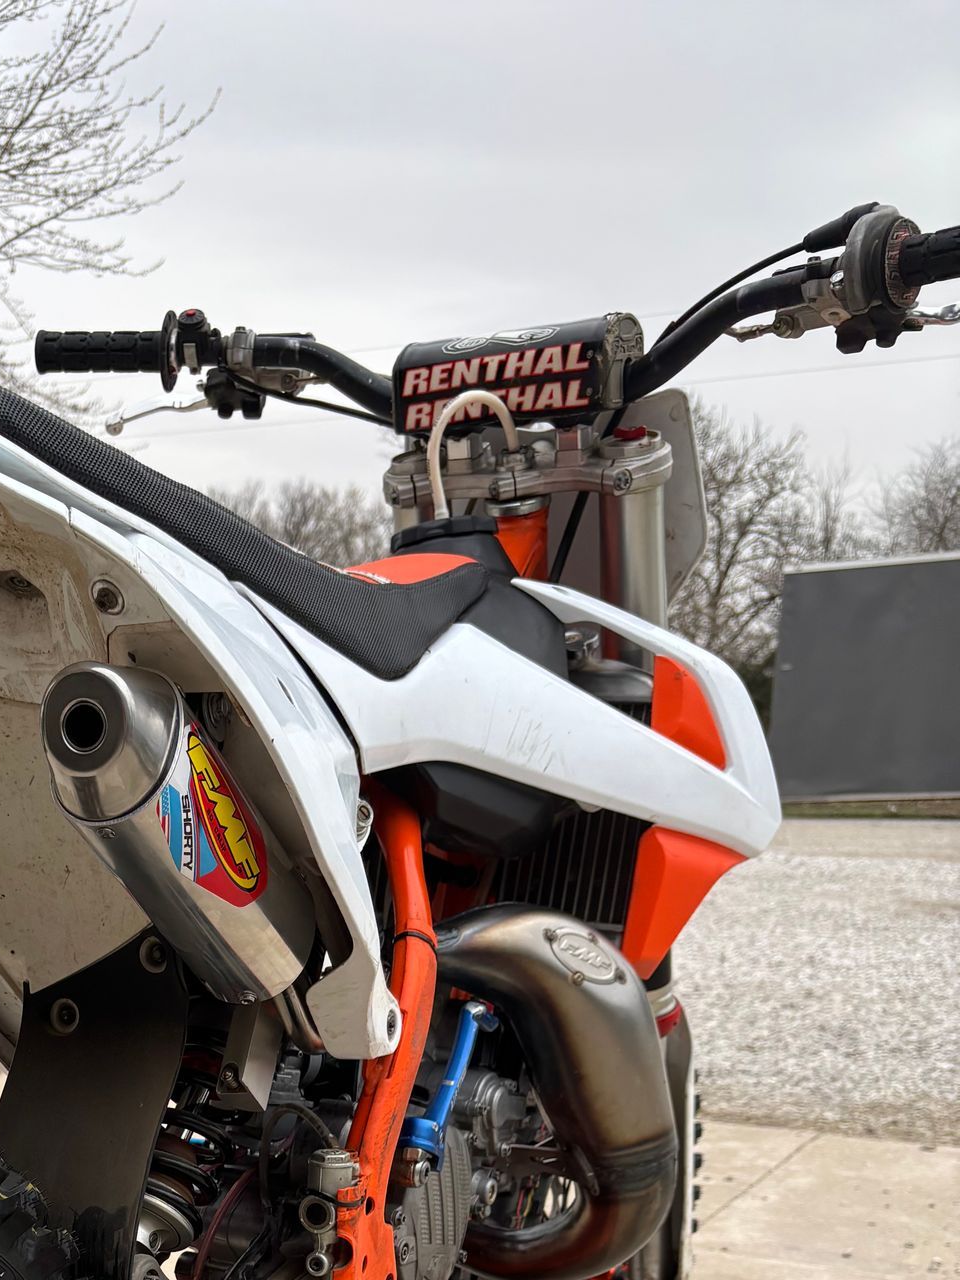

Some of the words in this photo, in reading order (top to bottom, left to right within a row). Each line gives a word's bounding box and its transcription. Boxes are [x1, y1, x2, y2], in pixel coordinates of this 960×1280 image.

[402, 341, 589, 397] RENTHAL
[181, 793, 193, 871] SHORTY
[187, 743, 261, 880] FMF
[560, 939, 612, 970] FMF
